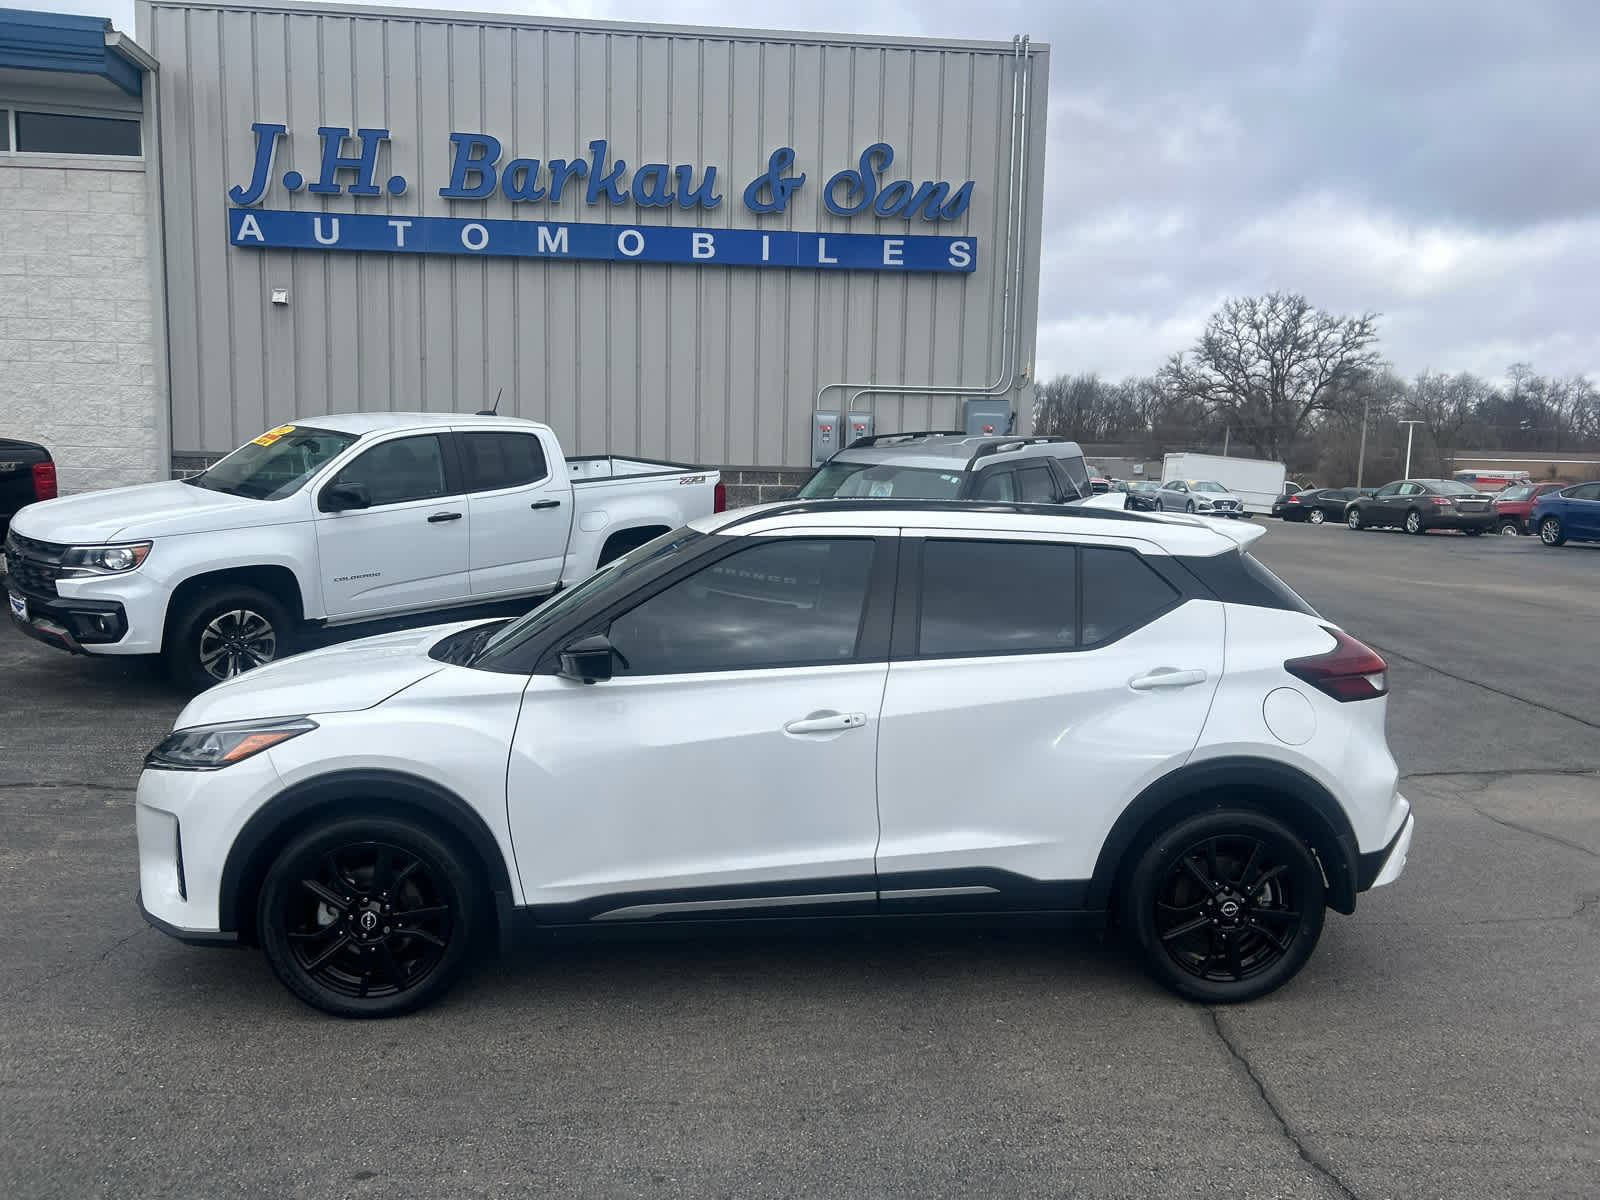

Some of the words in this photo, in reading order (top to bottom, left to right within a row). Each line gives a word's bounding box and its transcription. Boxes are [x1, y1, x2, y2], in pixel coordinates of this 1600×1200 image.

[228, 122, 408, 207] J.H.
[438, 132, 723, 209] Barkau
[742, 147, 806, 215] &
[823, 142, 975, 222] Sons
[235, 213, 972, 269] AUTOMOBILES
